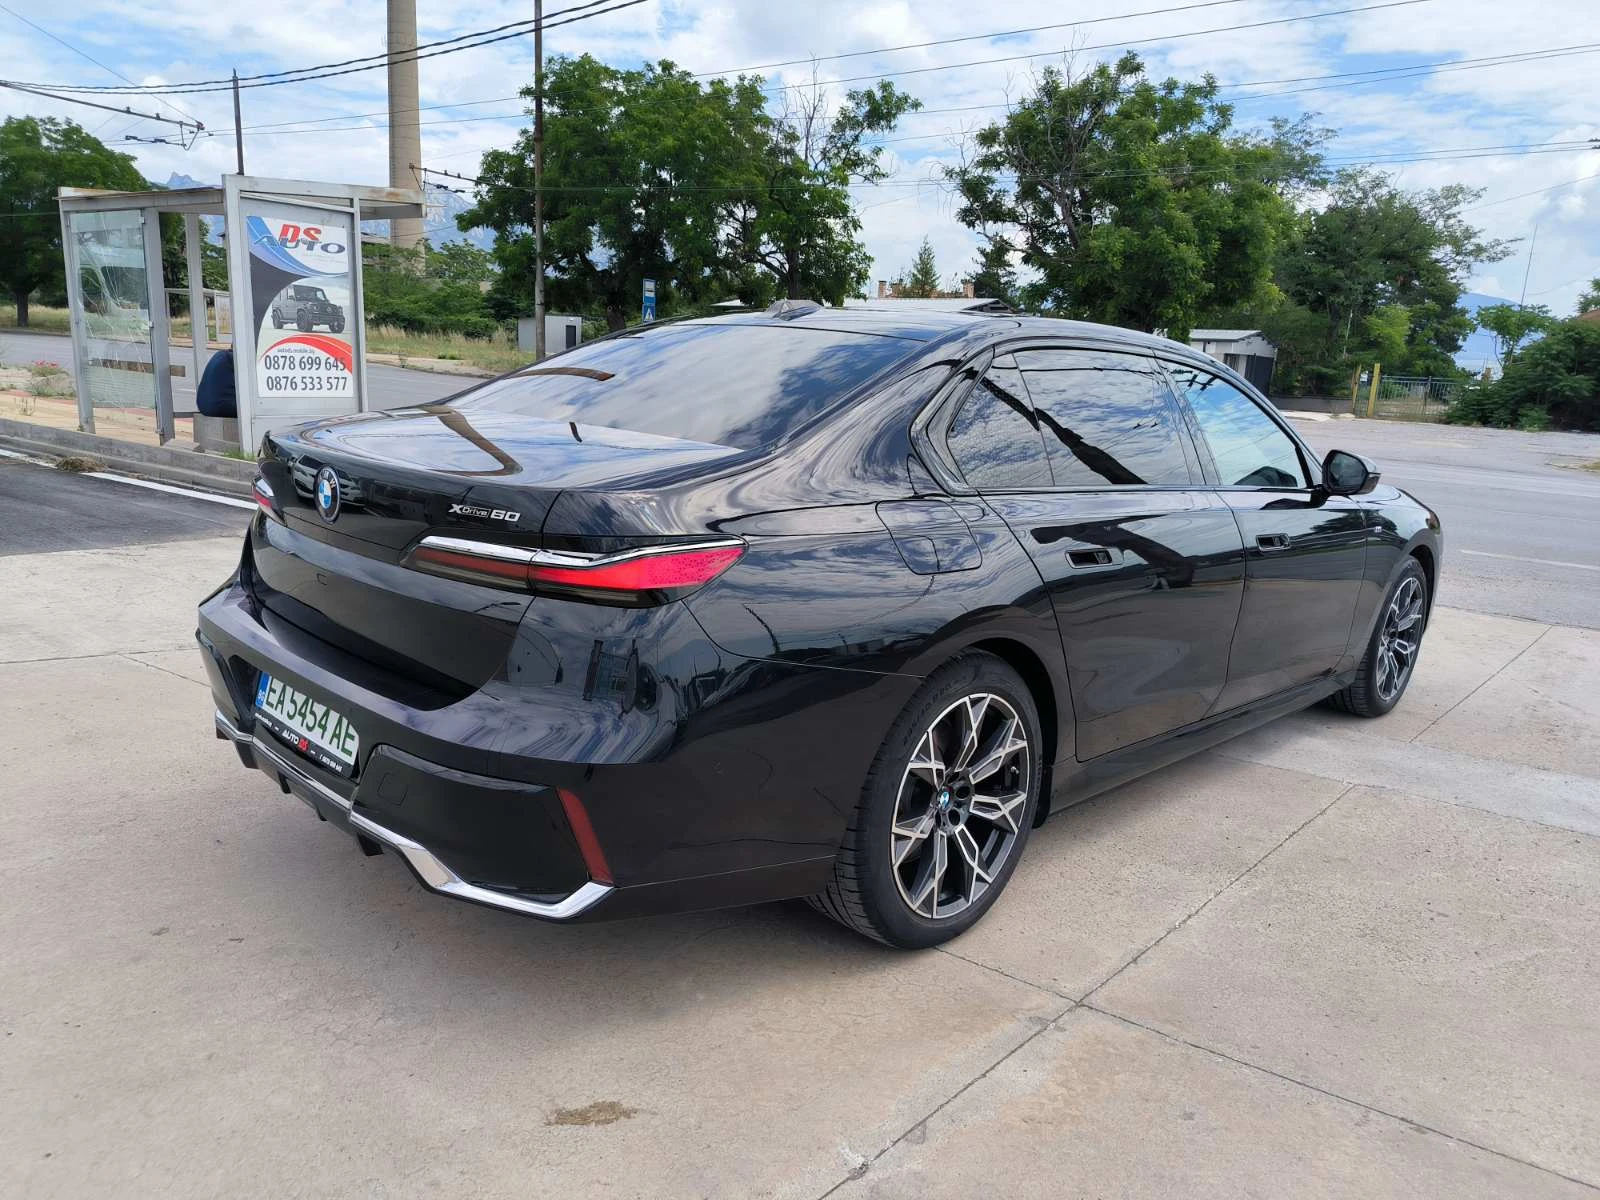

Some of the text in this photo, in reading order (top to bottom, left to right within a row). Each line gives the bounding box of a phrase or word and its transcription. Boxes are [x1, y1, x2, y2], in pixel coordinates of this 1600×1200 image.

[279, 223, 322, 243] DS
[254, 234, 346, 254] AUTO
[264, 354, 346, 371] 0878 699 645
[266, 376, 348, 391] 0876 533 577
